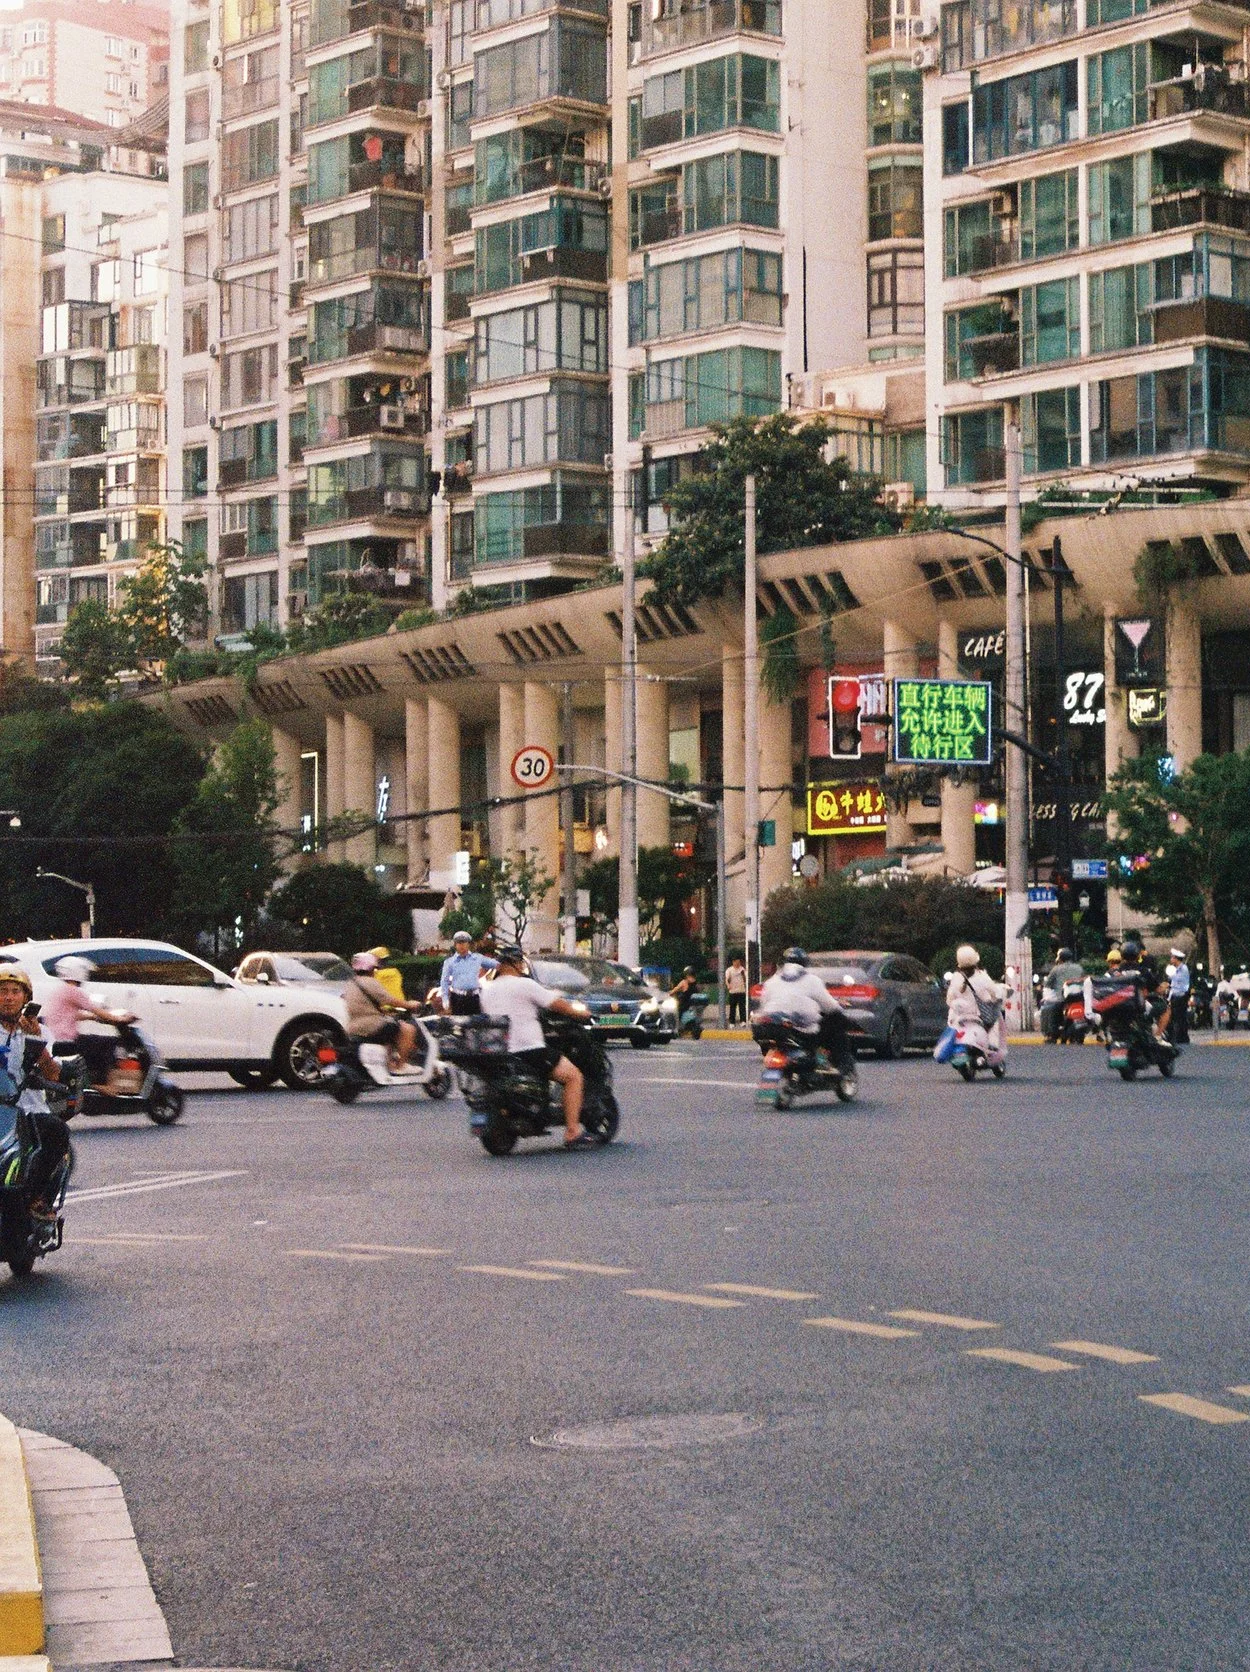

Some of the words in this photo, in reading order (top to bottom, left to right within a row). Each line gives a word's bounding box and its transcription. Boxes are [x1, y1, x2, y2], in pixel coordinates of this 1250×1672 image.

[899, 683, 985, 711] 直行车辆
[1063, 672, 1105, 710] 87
[900, 708, 986, 735] 允许进入
[911, 733, 974, 760] 待行区
[520, 757, 545, 777] 30
